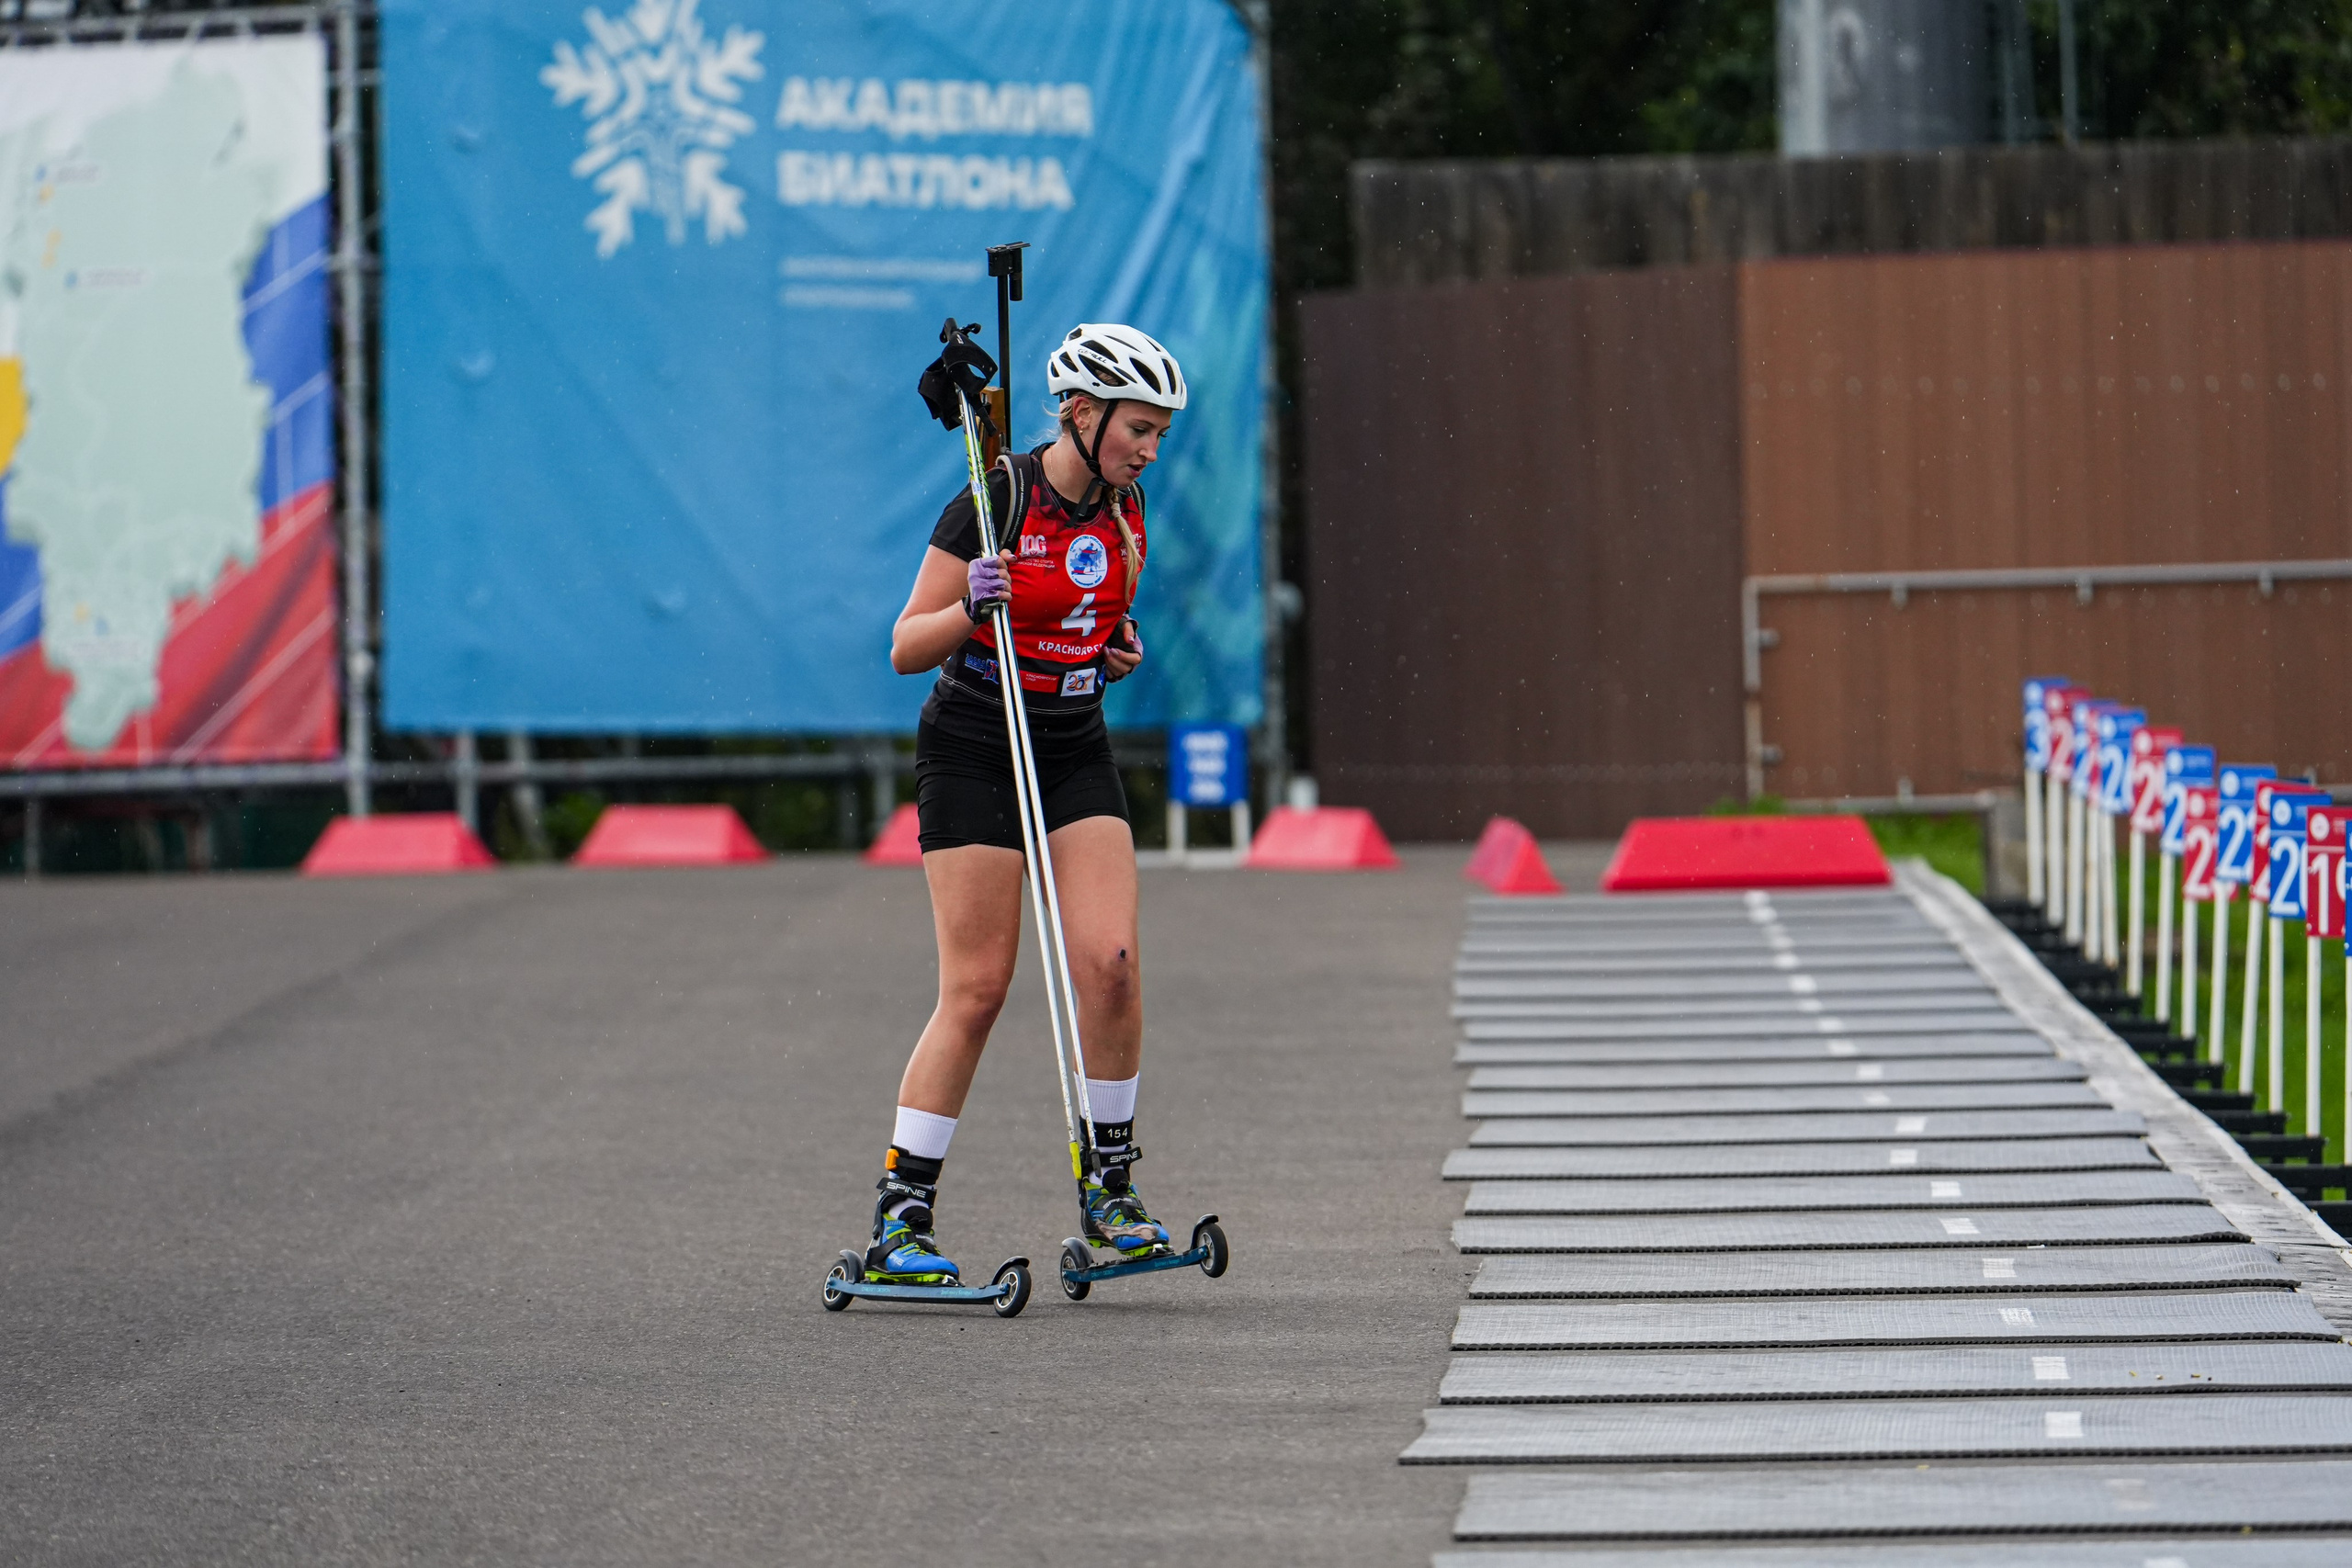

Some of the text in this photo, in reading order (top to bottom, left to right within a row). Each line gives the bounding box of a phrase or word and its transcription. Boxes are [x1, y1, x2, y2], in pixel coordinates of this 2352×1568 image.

[778, 77, 1093, 141] АКАДЕМИЯ
[778, 152, 1073, 209] БИАТЛОНА
[1061, 592, 1096, 637] 4
[2161, 782, 2188, 852] 2
[2184, 826, 2218, 898] 2
[2270, 836, 2308, 915] 2
[1107, 1127, 1128, 1138] 154
[1109, 1150, 1138, 1164] SPINE
[886, 1181, 926, 1198] SPINE
